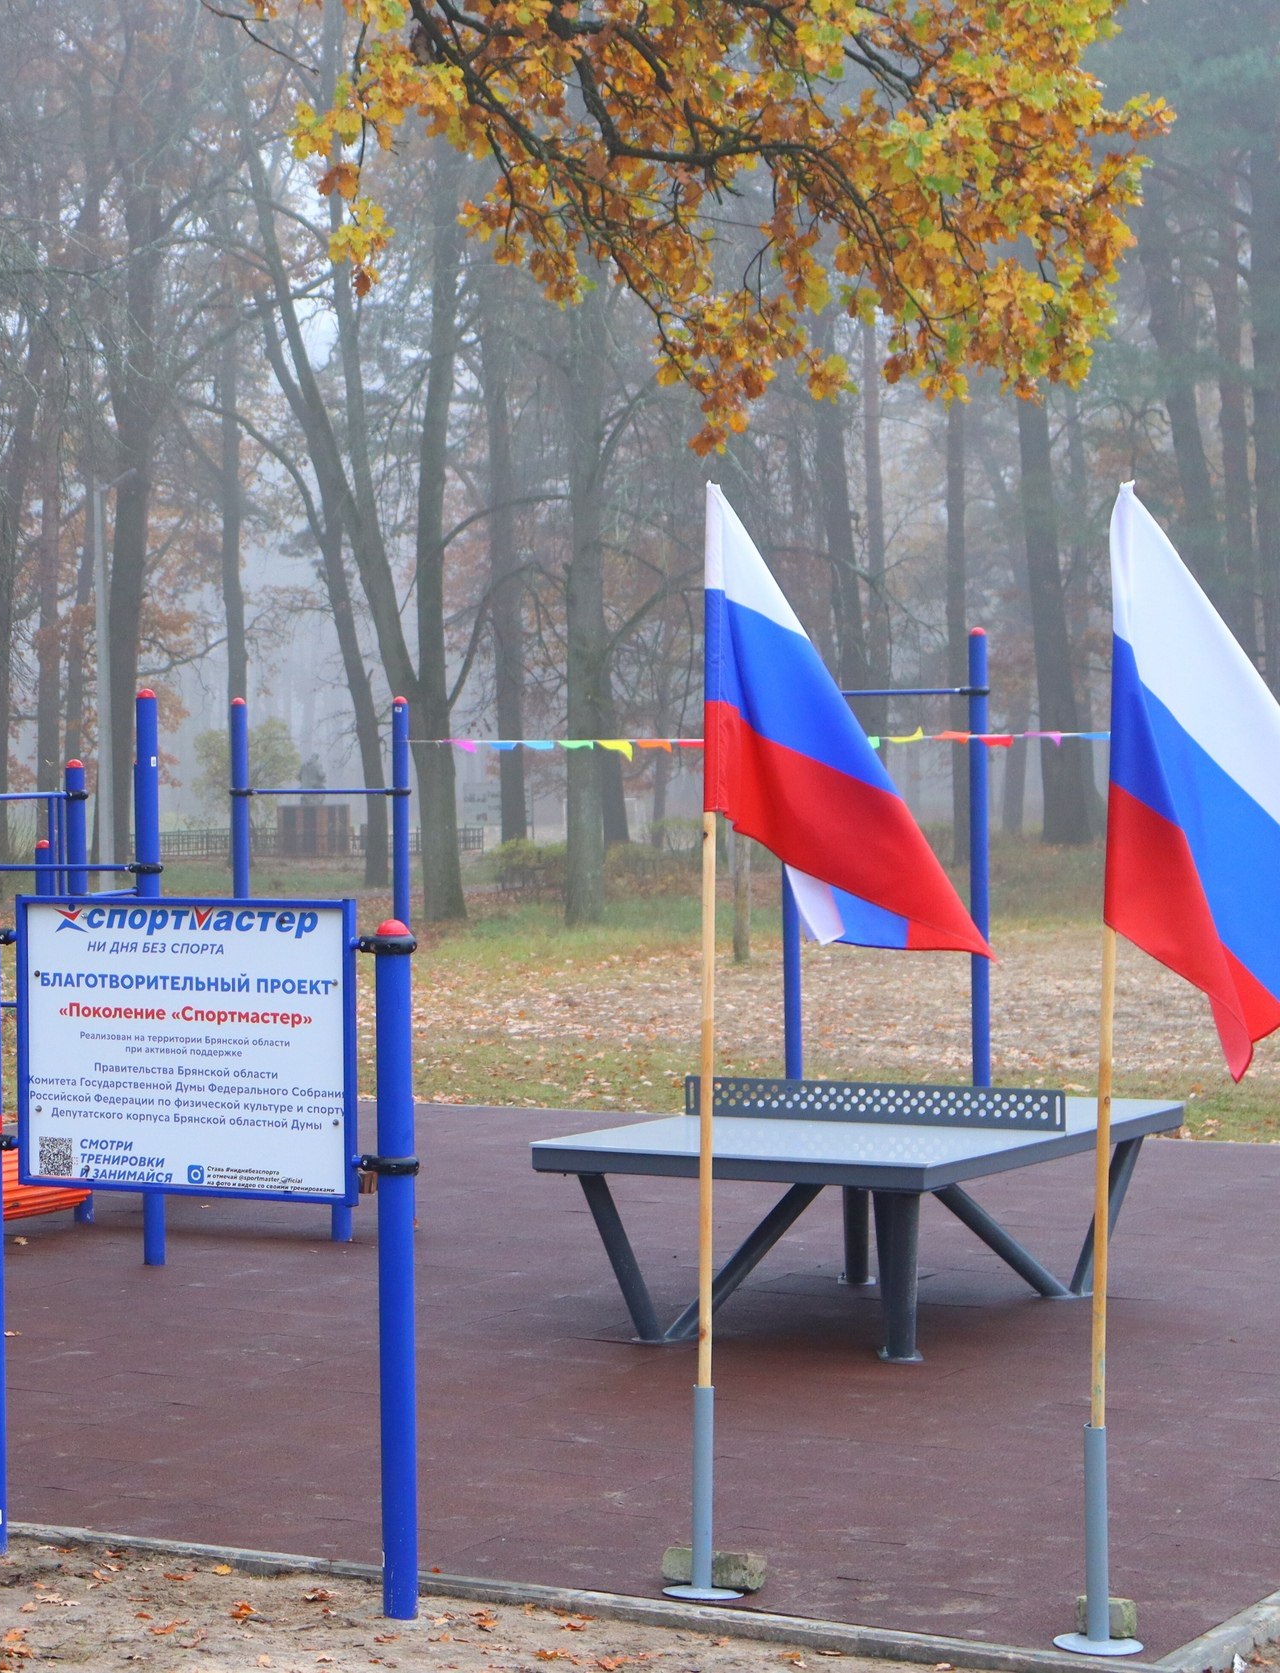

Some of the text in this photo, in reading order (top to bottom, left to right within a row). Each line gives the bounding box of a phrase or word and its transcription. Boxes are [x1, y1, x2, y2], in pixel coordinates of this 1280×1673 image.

[87, 941, 224, 955] НИ ДНЯ БЕЗ СПОРТА
[40, 972, 332, 996] БЛАГОТВОРИТЕЛЬНЫЙ ПРОЕКТ
[59, 1002, 313, 1028] «Поколение «Спортмастер»
[80, 1031, 291, 1048] Реализован на территории Брянской области
[125, 1046, 243, 1058] при активной поддержке
[94, 1062, 278, 1080] Правительства Брянской области
[29, 1075, 77, 1087] Комитета
[80, 1077, 172, 1091] Государственной
[175, 1081, 205, 1094] Думы
[208, 1083, 289, 1097] Федерального
[30, 1090, 91, 1102] Российской
[94, 1093, 155, 1107] Федерации
[158, 1098, 171, 1107] по
[174, 1098, 240, 1111] физической
[243, 1102, 293, 1115] культуре
[296, 1105, 304, 1113] и
[51, 1107, 322, 1132] Депутатского корпуса Брянской областной Думы
[80, 1138, 133, 1151] СМОТРИ
[80, 1153, 165, 1168] ТРЕНИРОВКИ
[92, 1168, 173, 1183] ЗАНИМАЙСЯ
